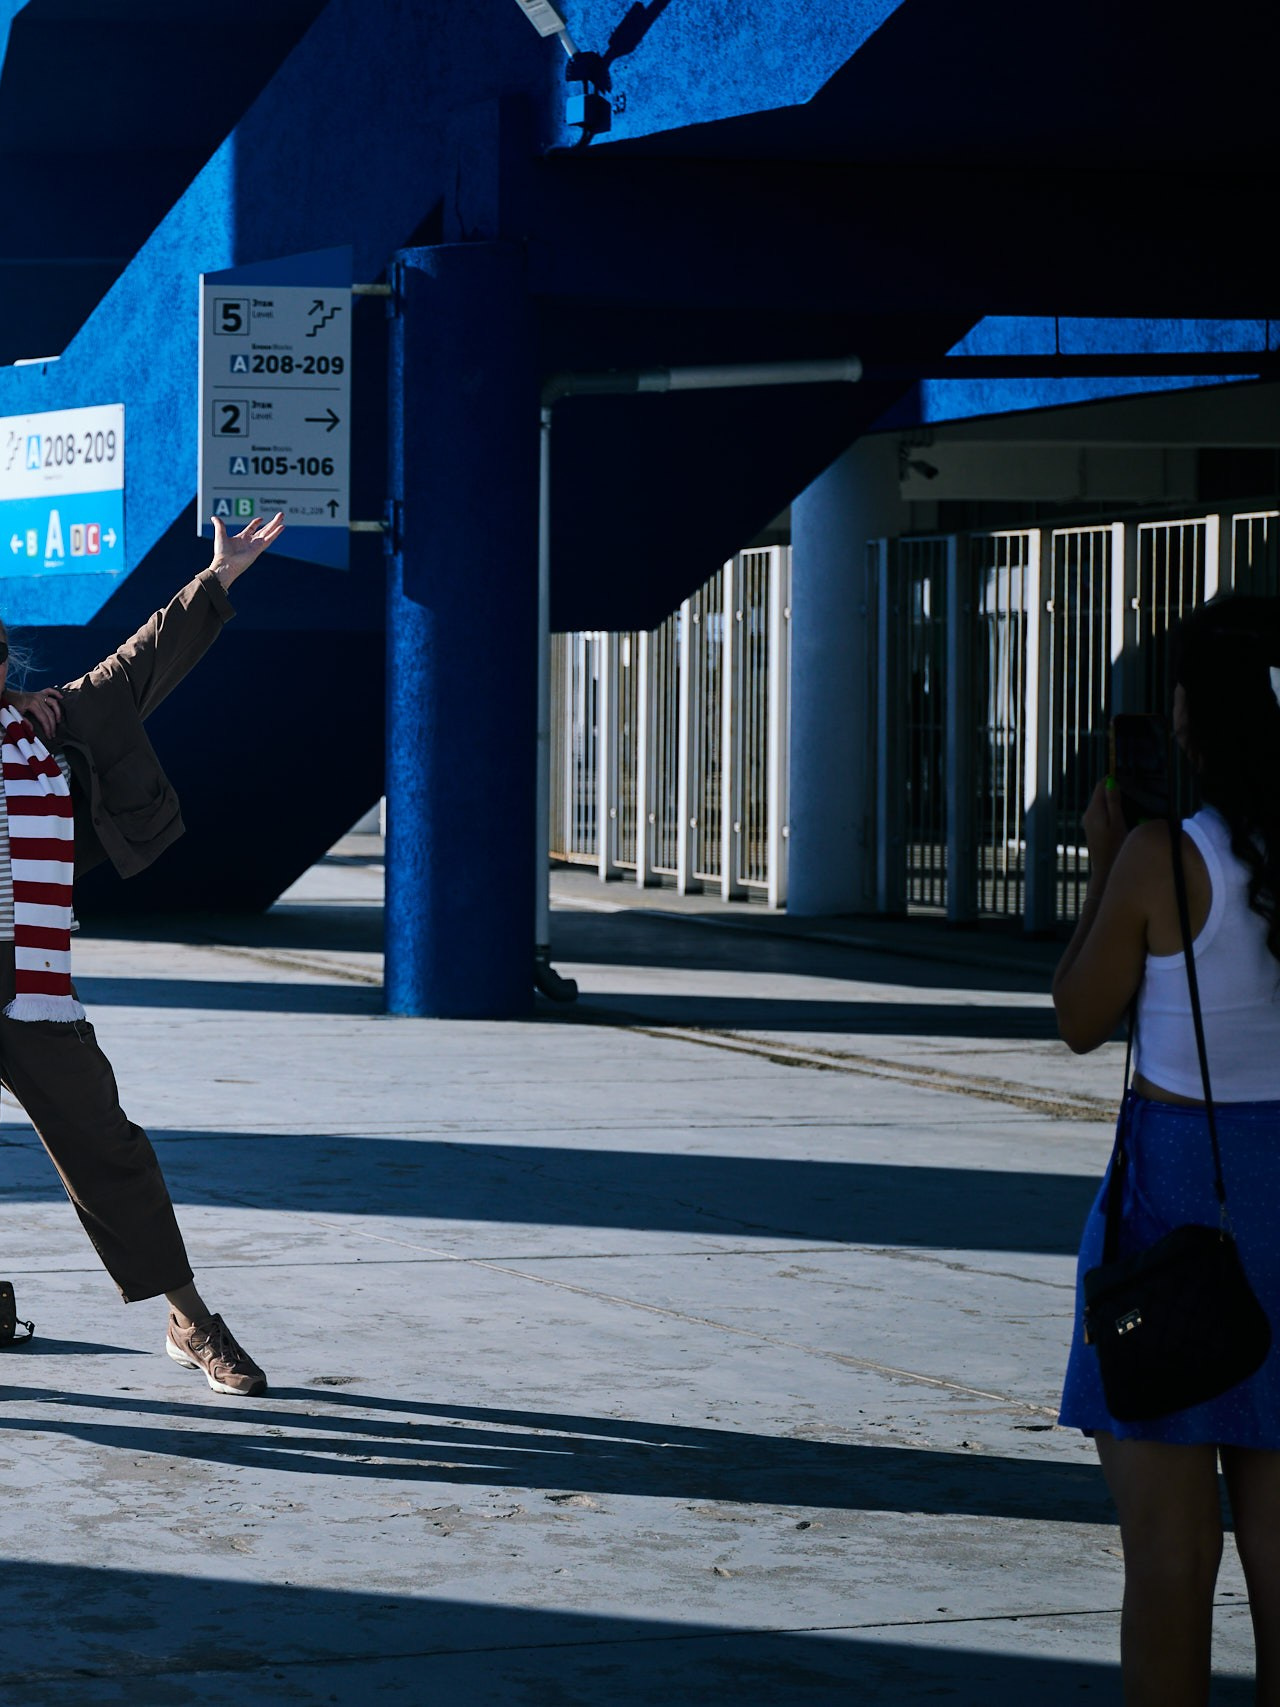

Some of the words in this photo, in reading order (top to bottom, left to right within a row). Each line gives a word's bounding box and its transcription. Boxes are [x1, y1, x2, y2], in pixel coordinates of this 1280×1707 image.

[222, 303, 242, 332] 5
[232, 355, 247, 372] A
[252, 355, 344, 375] 208-209
[220, 404, 241, 434] 2
[27, 435, 41, 469] A
[44, 430, 116, 467] 208-209
[231, 457, 247, 475] A
[251, 456, 334, 476] 105-106
[215, 499, 230, 516] A
[237, 499, 252, 515] B
[44, 509, 65, 559] A
[87, 525, 100, 554] C
